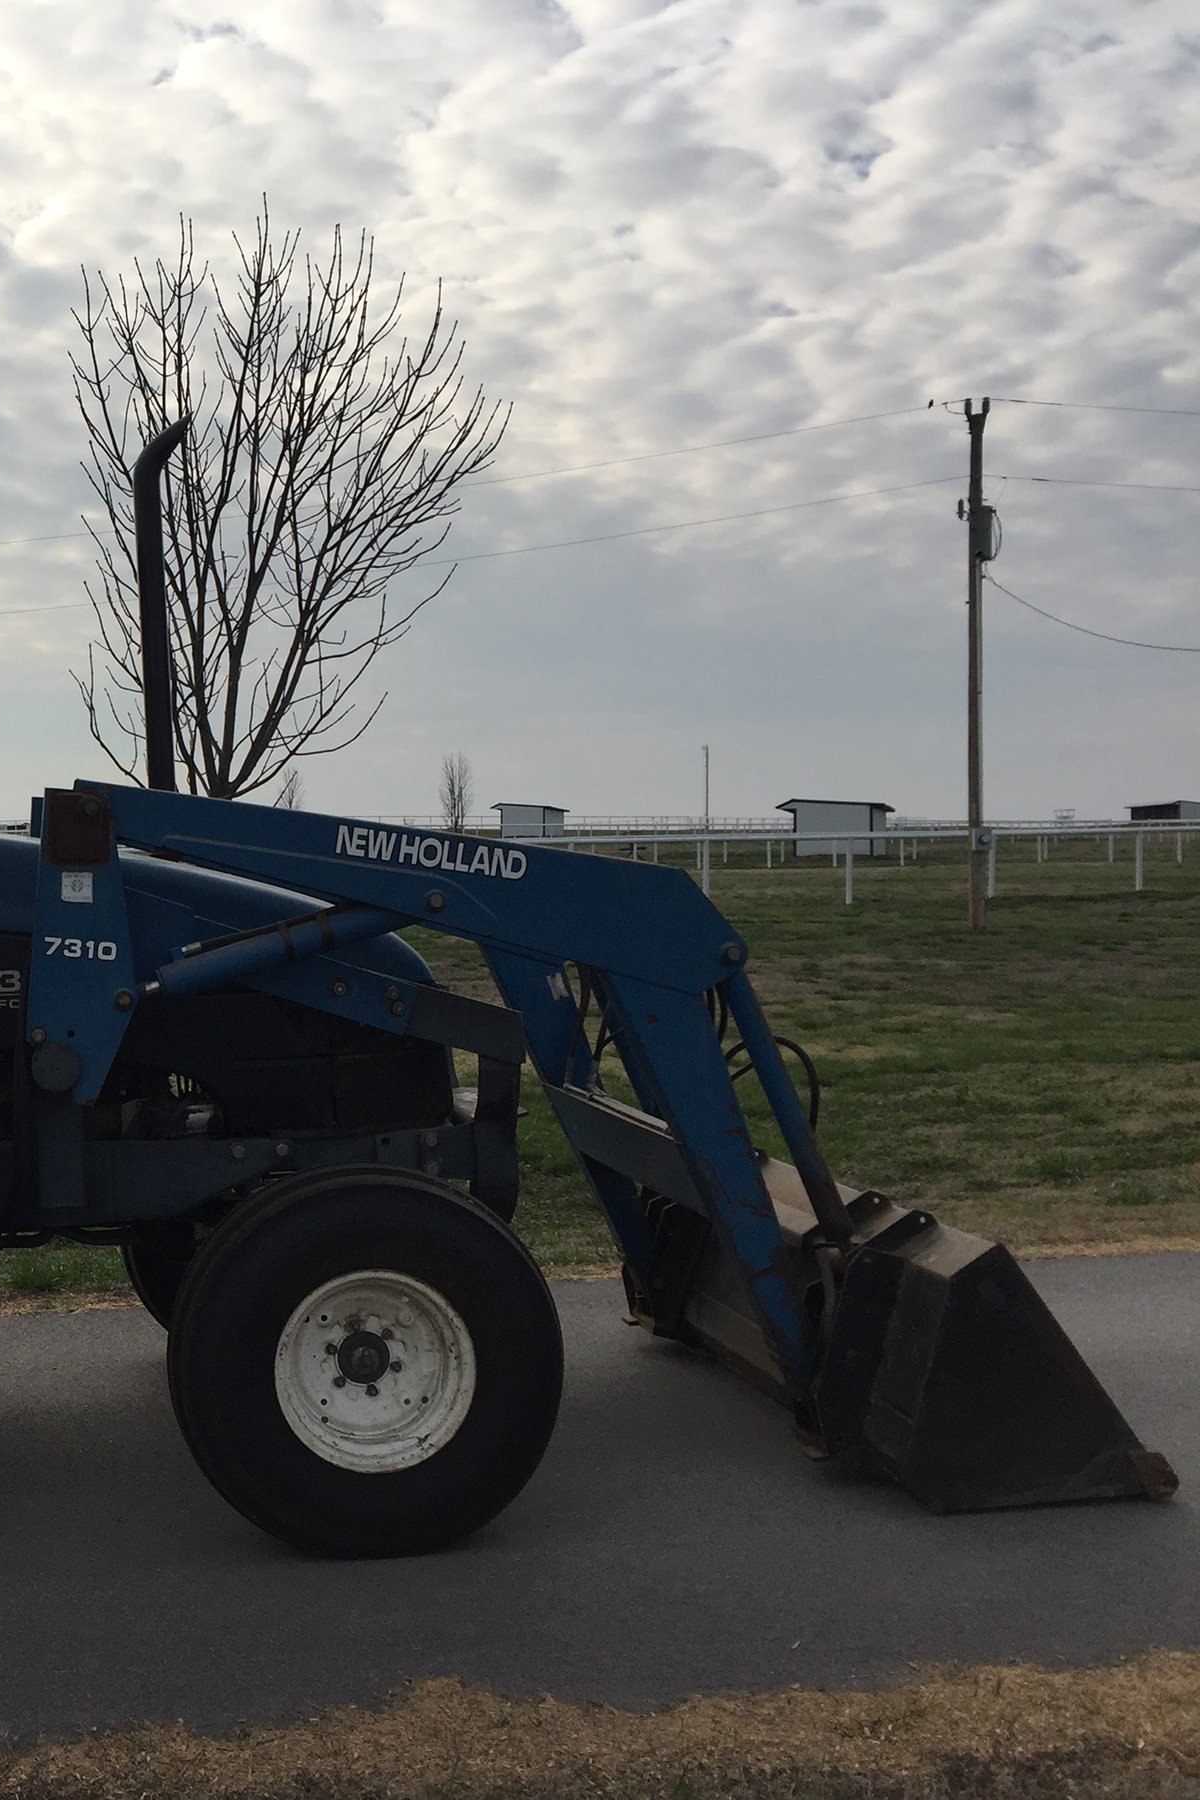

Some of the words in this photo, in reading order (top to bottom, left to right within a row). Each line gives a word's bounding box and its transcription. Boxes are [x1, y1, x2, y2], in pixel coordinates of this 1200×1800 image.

[335, 824, 397, 861] NEW
[398, 834, 527, 880] HOLLAND
[43, 936, 117, 961] 7310
